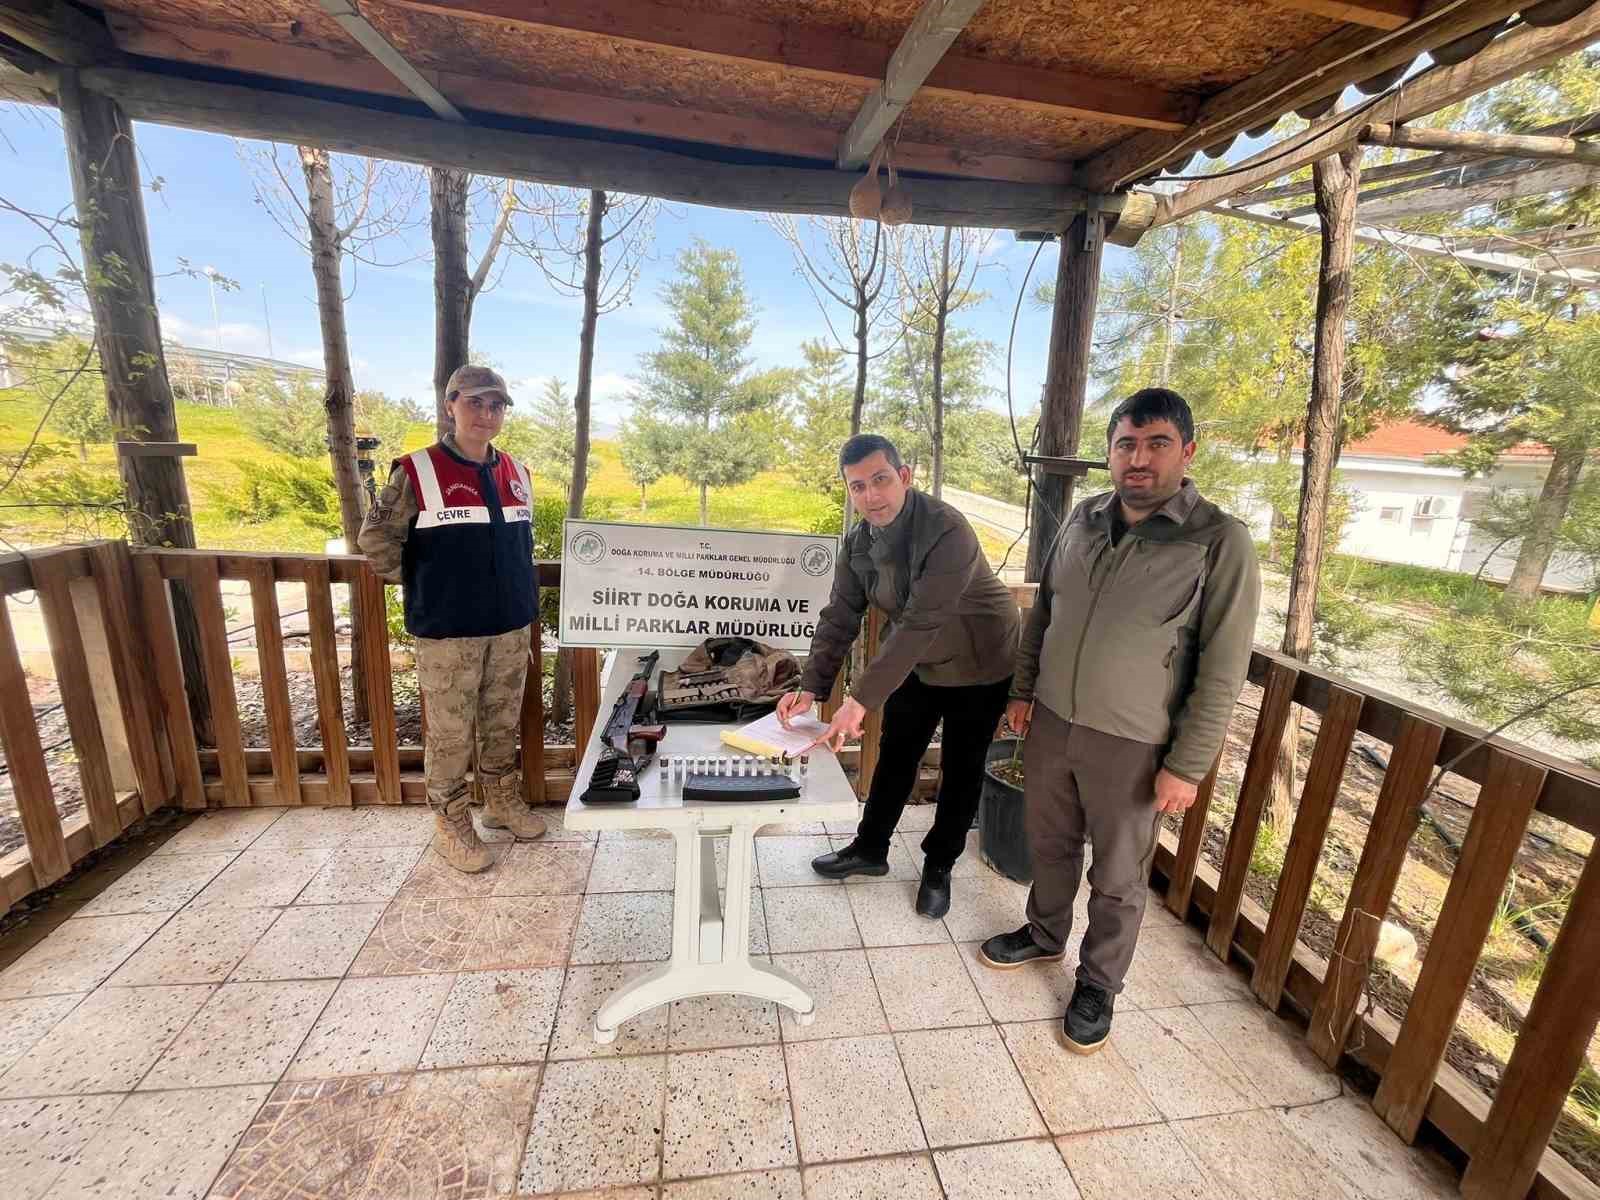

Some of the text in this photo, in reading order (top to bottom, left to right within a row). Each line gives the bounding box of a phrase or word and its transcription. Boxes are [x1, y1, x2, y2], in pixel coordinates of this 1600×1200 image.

[436, 509, 471, 521] ÇEVRE
[611, 547, 632, 557] DOĞA
[633, 549, 664, 558] KORUMA
[665, 551, 675, 559] VE
[696, 552, 728, 562] PARKLAR
[729, 554, 751, 563] GENEL
[638, 567, 770, 582] 14. BÖLGE MÜDÜRLÜĞÜ
[592, 588, 809, 614] SİİRT DOĞA KORUMA VE
[569, 614, 815, 638] MİLLİ PARKLAR MÜDÜRLÜĞ
